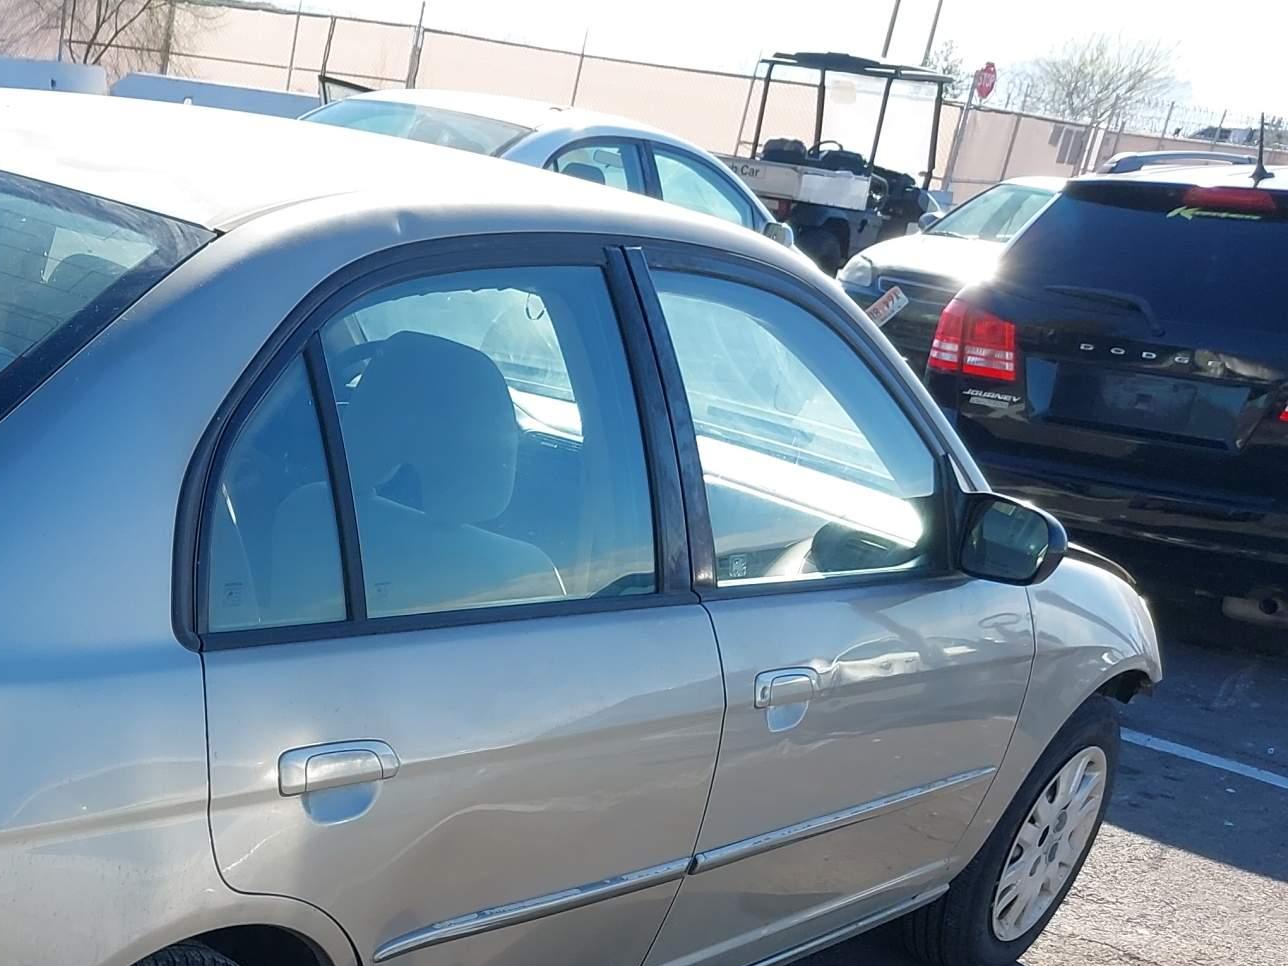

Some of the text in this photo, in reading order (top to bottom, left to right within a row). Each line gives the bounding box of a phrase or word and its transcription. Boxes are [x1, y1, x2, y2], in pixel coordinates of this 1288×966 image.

[977, 71, 996, 87] STOP
[740, 164, 760, 177] Car
[962, 388, 1021, 402] JOURNEY
